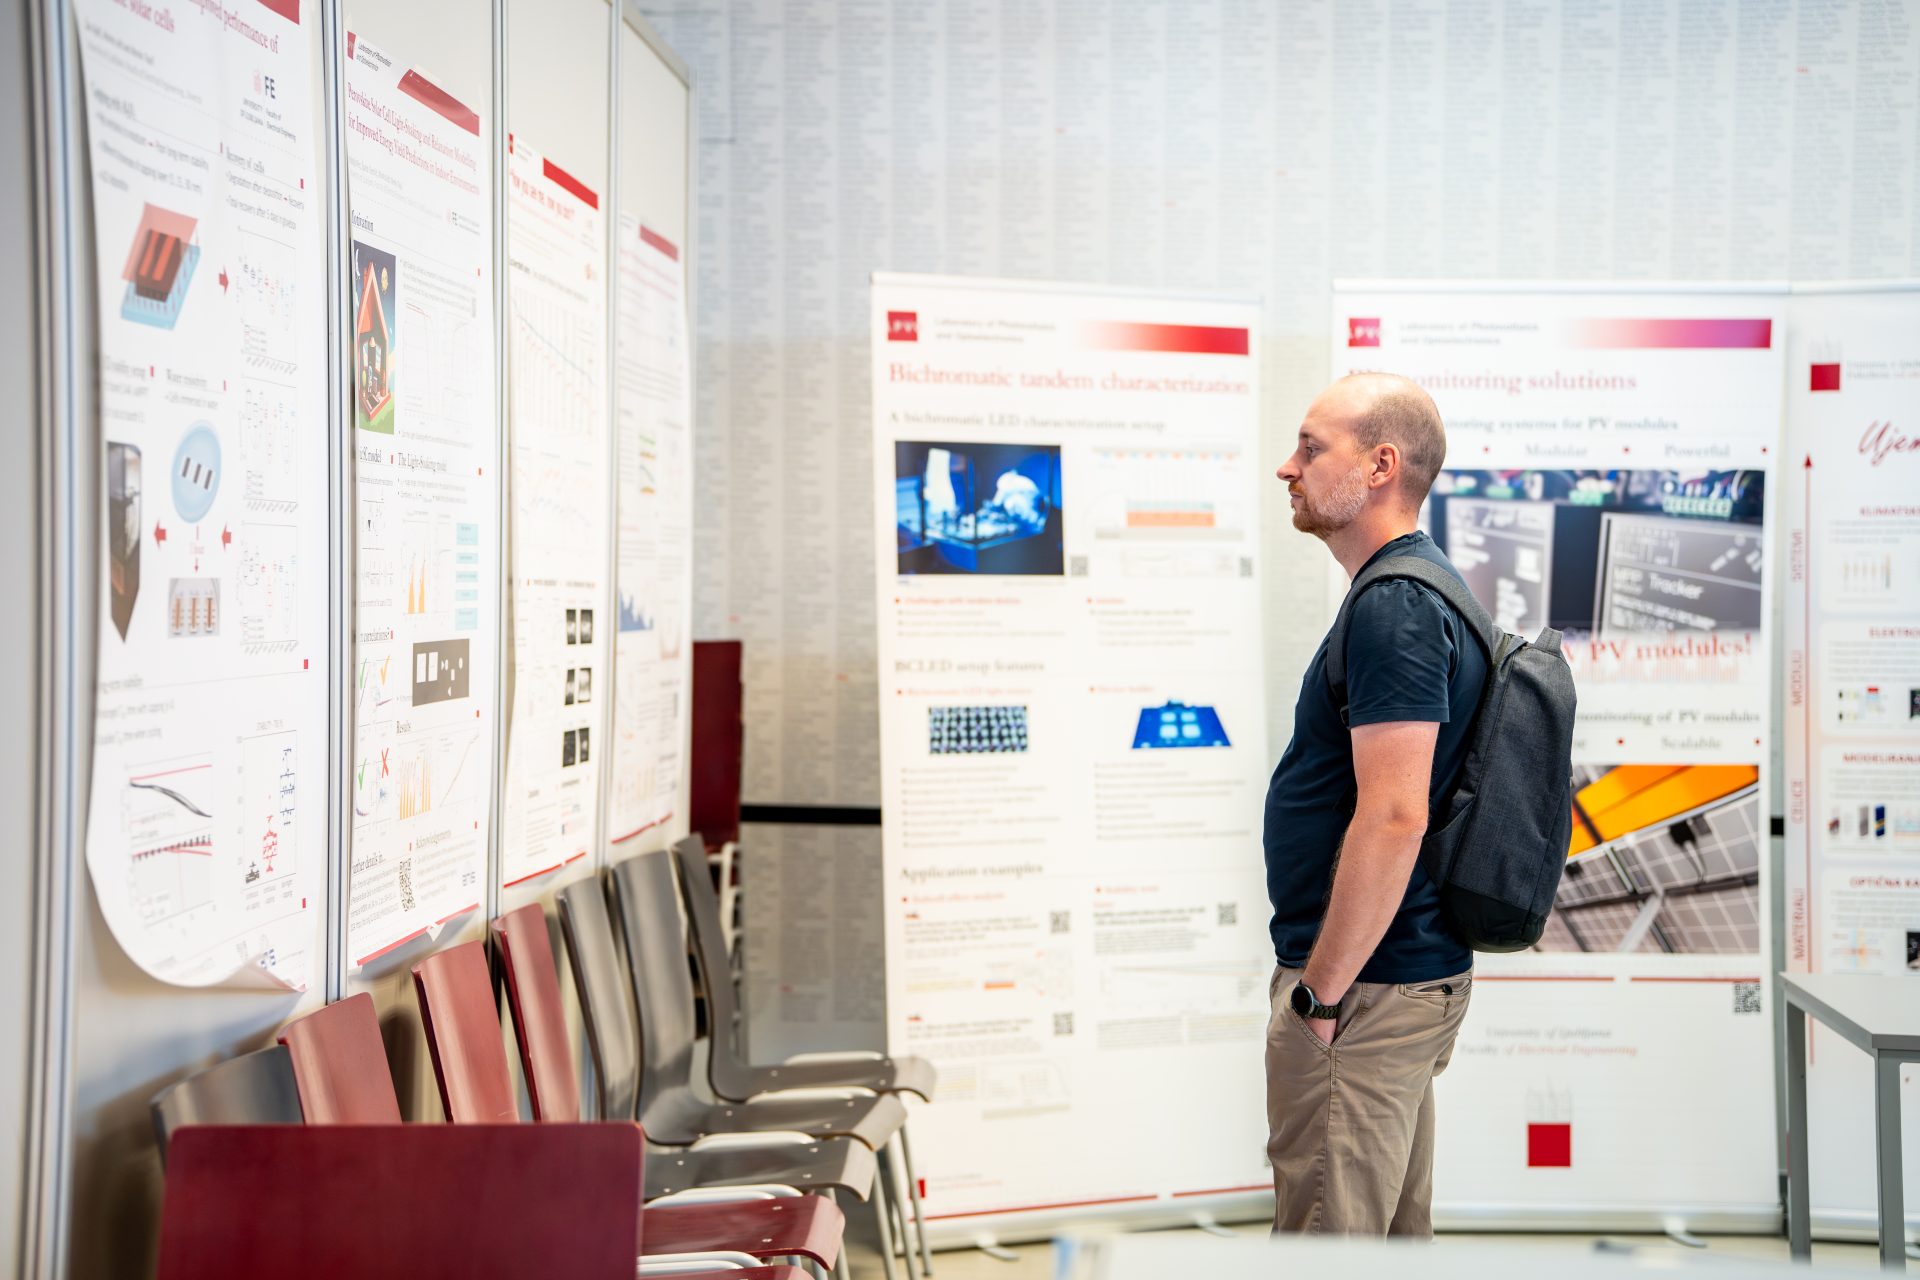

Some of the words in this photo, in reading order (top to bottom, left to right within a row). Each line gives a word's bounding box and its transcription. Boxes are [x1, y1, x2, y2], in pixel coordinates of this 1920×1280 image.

[264, 75, 276, 99] FE
[889, 363, 1012, 388] Bichromatic
[1019, 369, 1094, 391] tandem
[1101, 370, 1249, 395] characterization
[1413, 368, 1522, 396] onitoring
[1527, 368, 1637, 391] solutions
[988, 412, 1020, 427] LED
[1587, 415, 1611, 429] PV
[1649, 571, 1704, 600] Tracker
[1590, 640, 1627, 662] PV
[1636, 632, 1751, 660] modules!
[899, 864, 978, 885] Application
[980, 860, 1043, 881] examples
